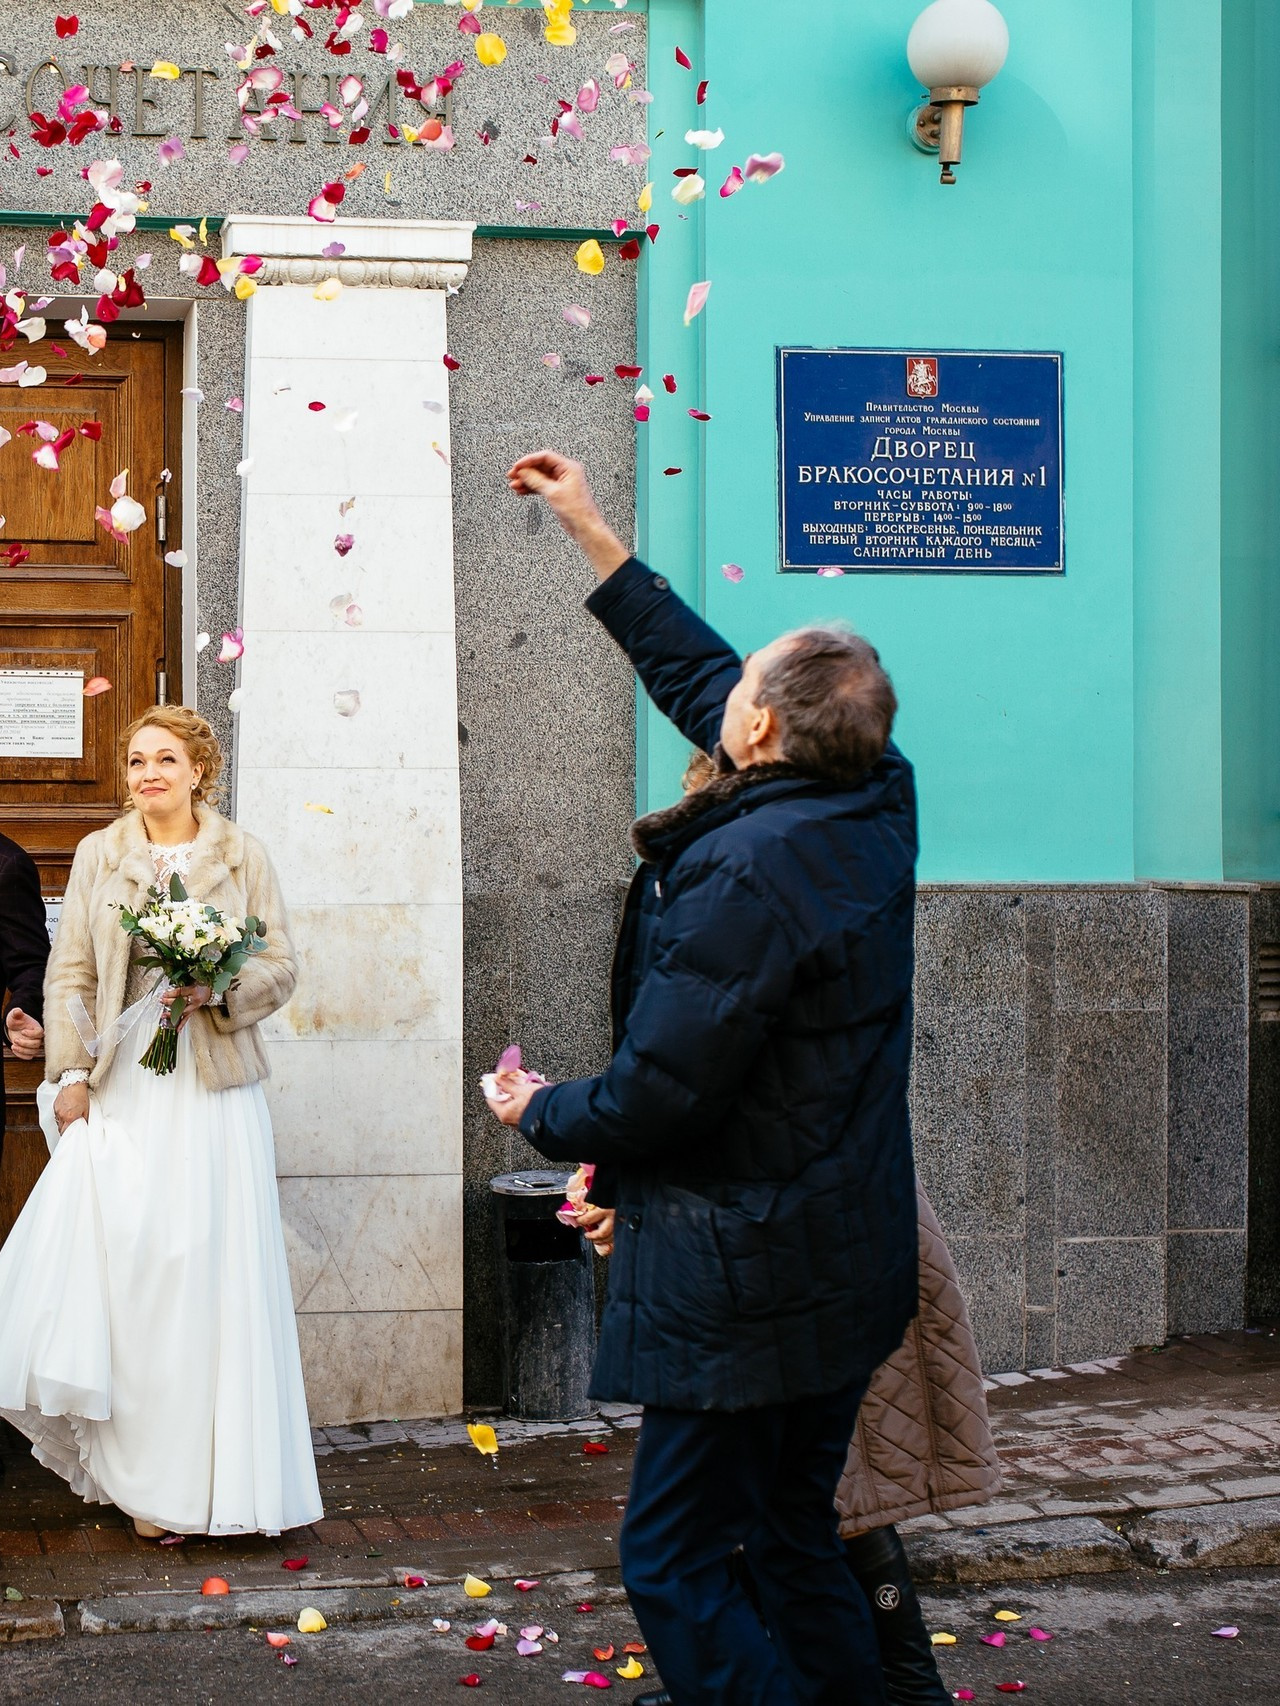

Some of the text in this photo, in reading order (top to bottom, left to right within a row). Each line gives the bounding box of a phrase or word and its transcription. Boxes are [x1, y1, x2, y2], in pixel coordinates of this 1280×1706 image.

[871, 437, 976, 462] ДВОРЕЦ
[798, 466, 1014, 485] БРАКОСОЧЕТАНИЯ
[877, 490, 972, 500] ЧАСЫ РАБОТЫ:
[865, 513, 924, 522] ПЕРЕРЫВ:
[803, 524, 868, 533] ВЫХОДНЫЕ:
[964, 526, 1042, 536] ПОНЕДЕЛЬНИК
[810, 534, 857, 544] ПЕРВЫЙ
[866, 536, 918, 545] ВТОРНИК
[927, 537, 982, 546] КАЖДОГО
[854, 547, 992, 559] САНИТАРНЫЙ ДЕНЬ
